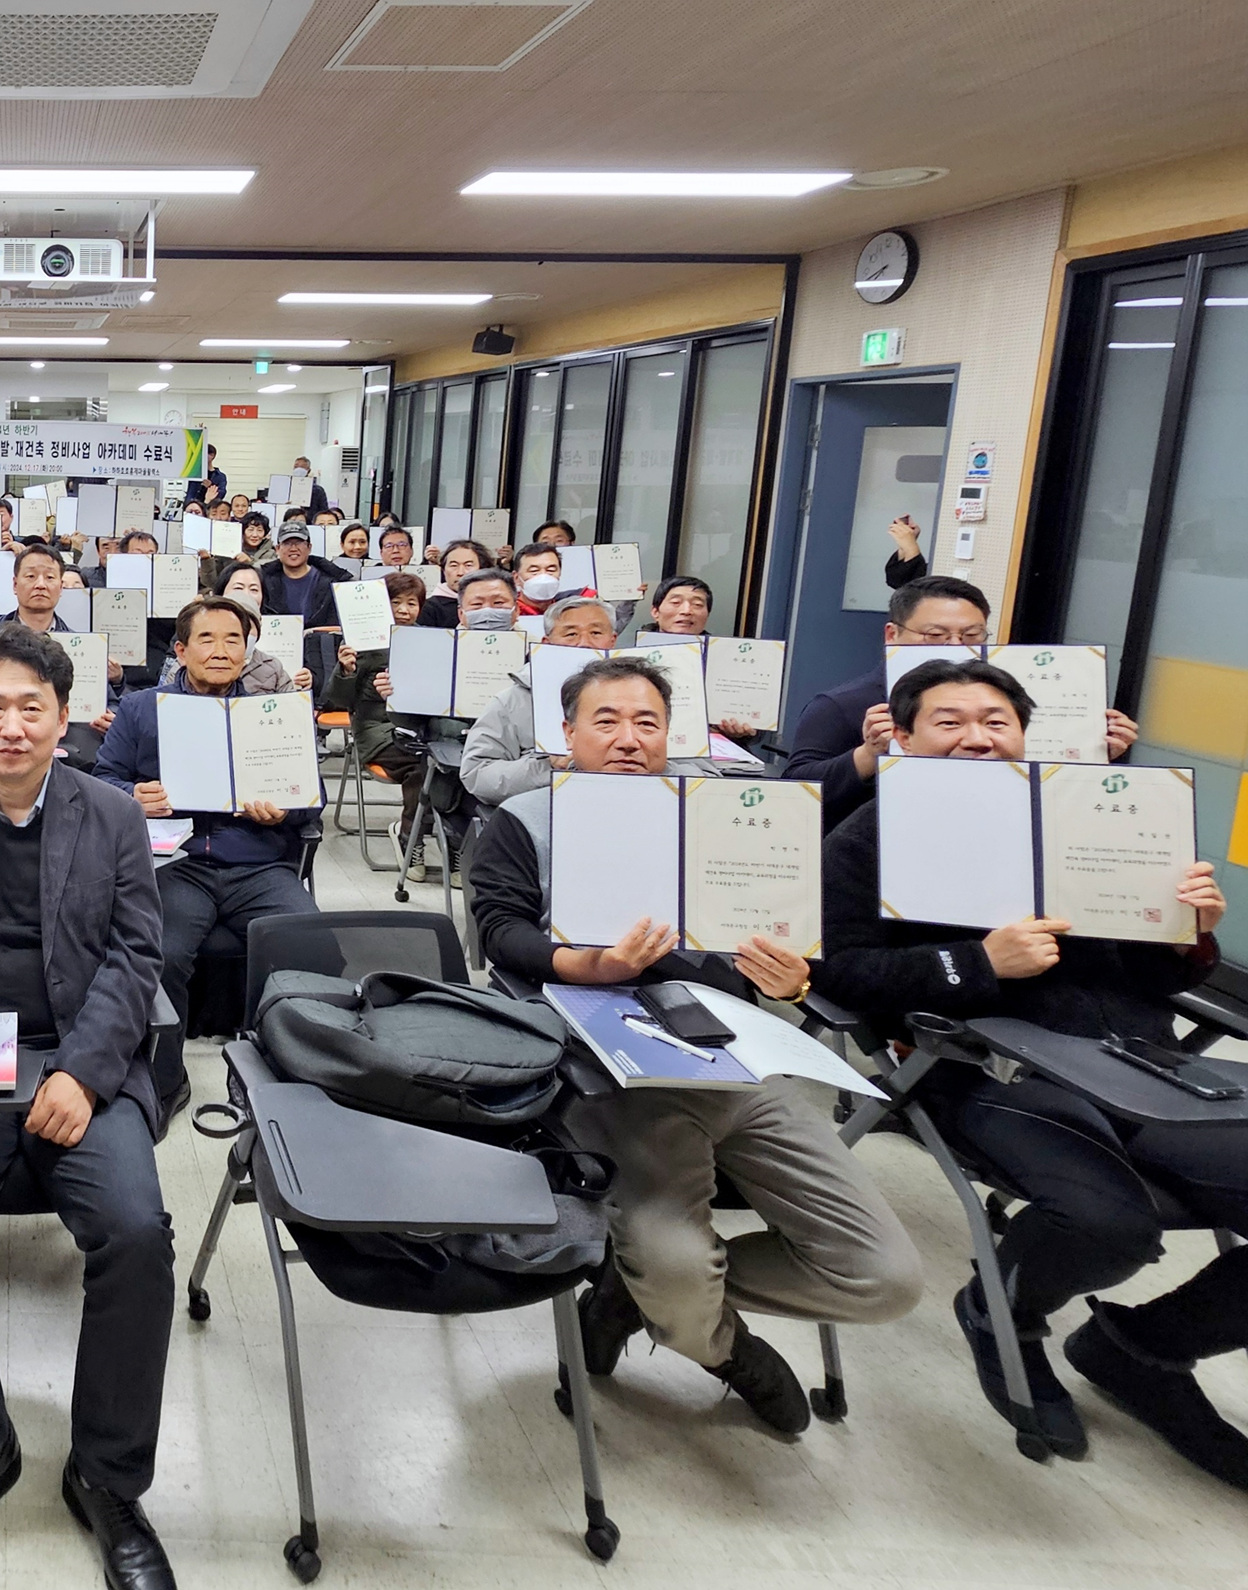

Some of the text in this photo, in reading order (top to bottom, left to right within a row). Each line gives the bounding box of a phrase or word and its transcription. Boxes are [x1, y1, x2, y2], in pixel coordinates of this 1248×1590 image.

[15, 425, 38, 436] 하반기
[50, 441, 91, 460] 정비사업
[97, 442, 137, 461] 아카데미
[143, 444, 173, 463] 수료식
[1094, 802, 1139, 815] 수료증
[732, 817, 772, 828] 수료증
